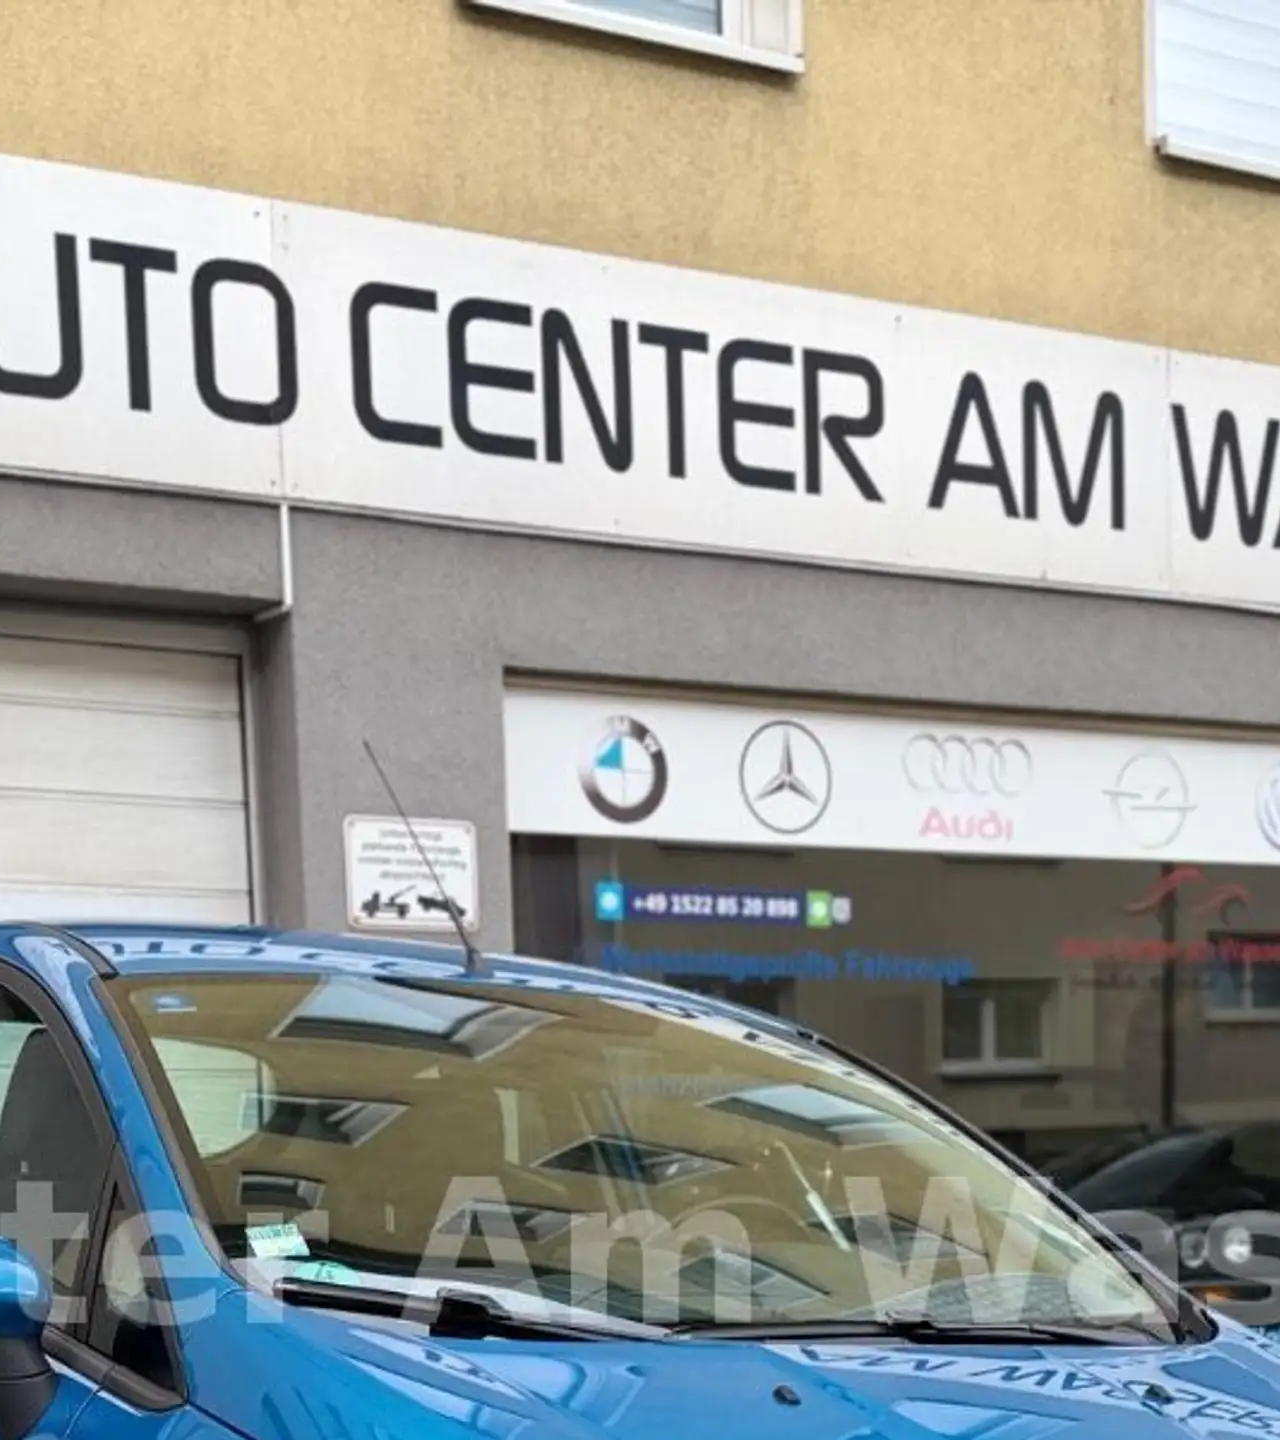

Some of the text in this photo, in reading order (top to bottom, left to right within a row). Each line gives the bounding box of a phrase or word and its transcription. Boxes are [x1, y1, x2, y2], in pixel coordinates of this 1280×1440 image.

[349, 281, 886, 503] CENTER
[928, 371, 1125, 531] AM
[919, 806, 1017, 842] Audi
